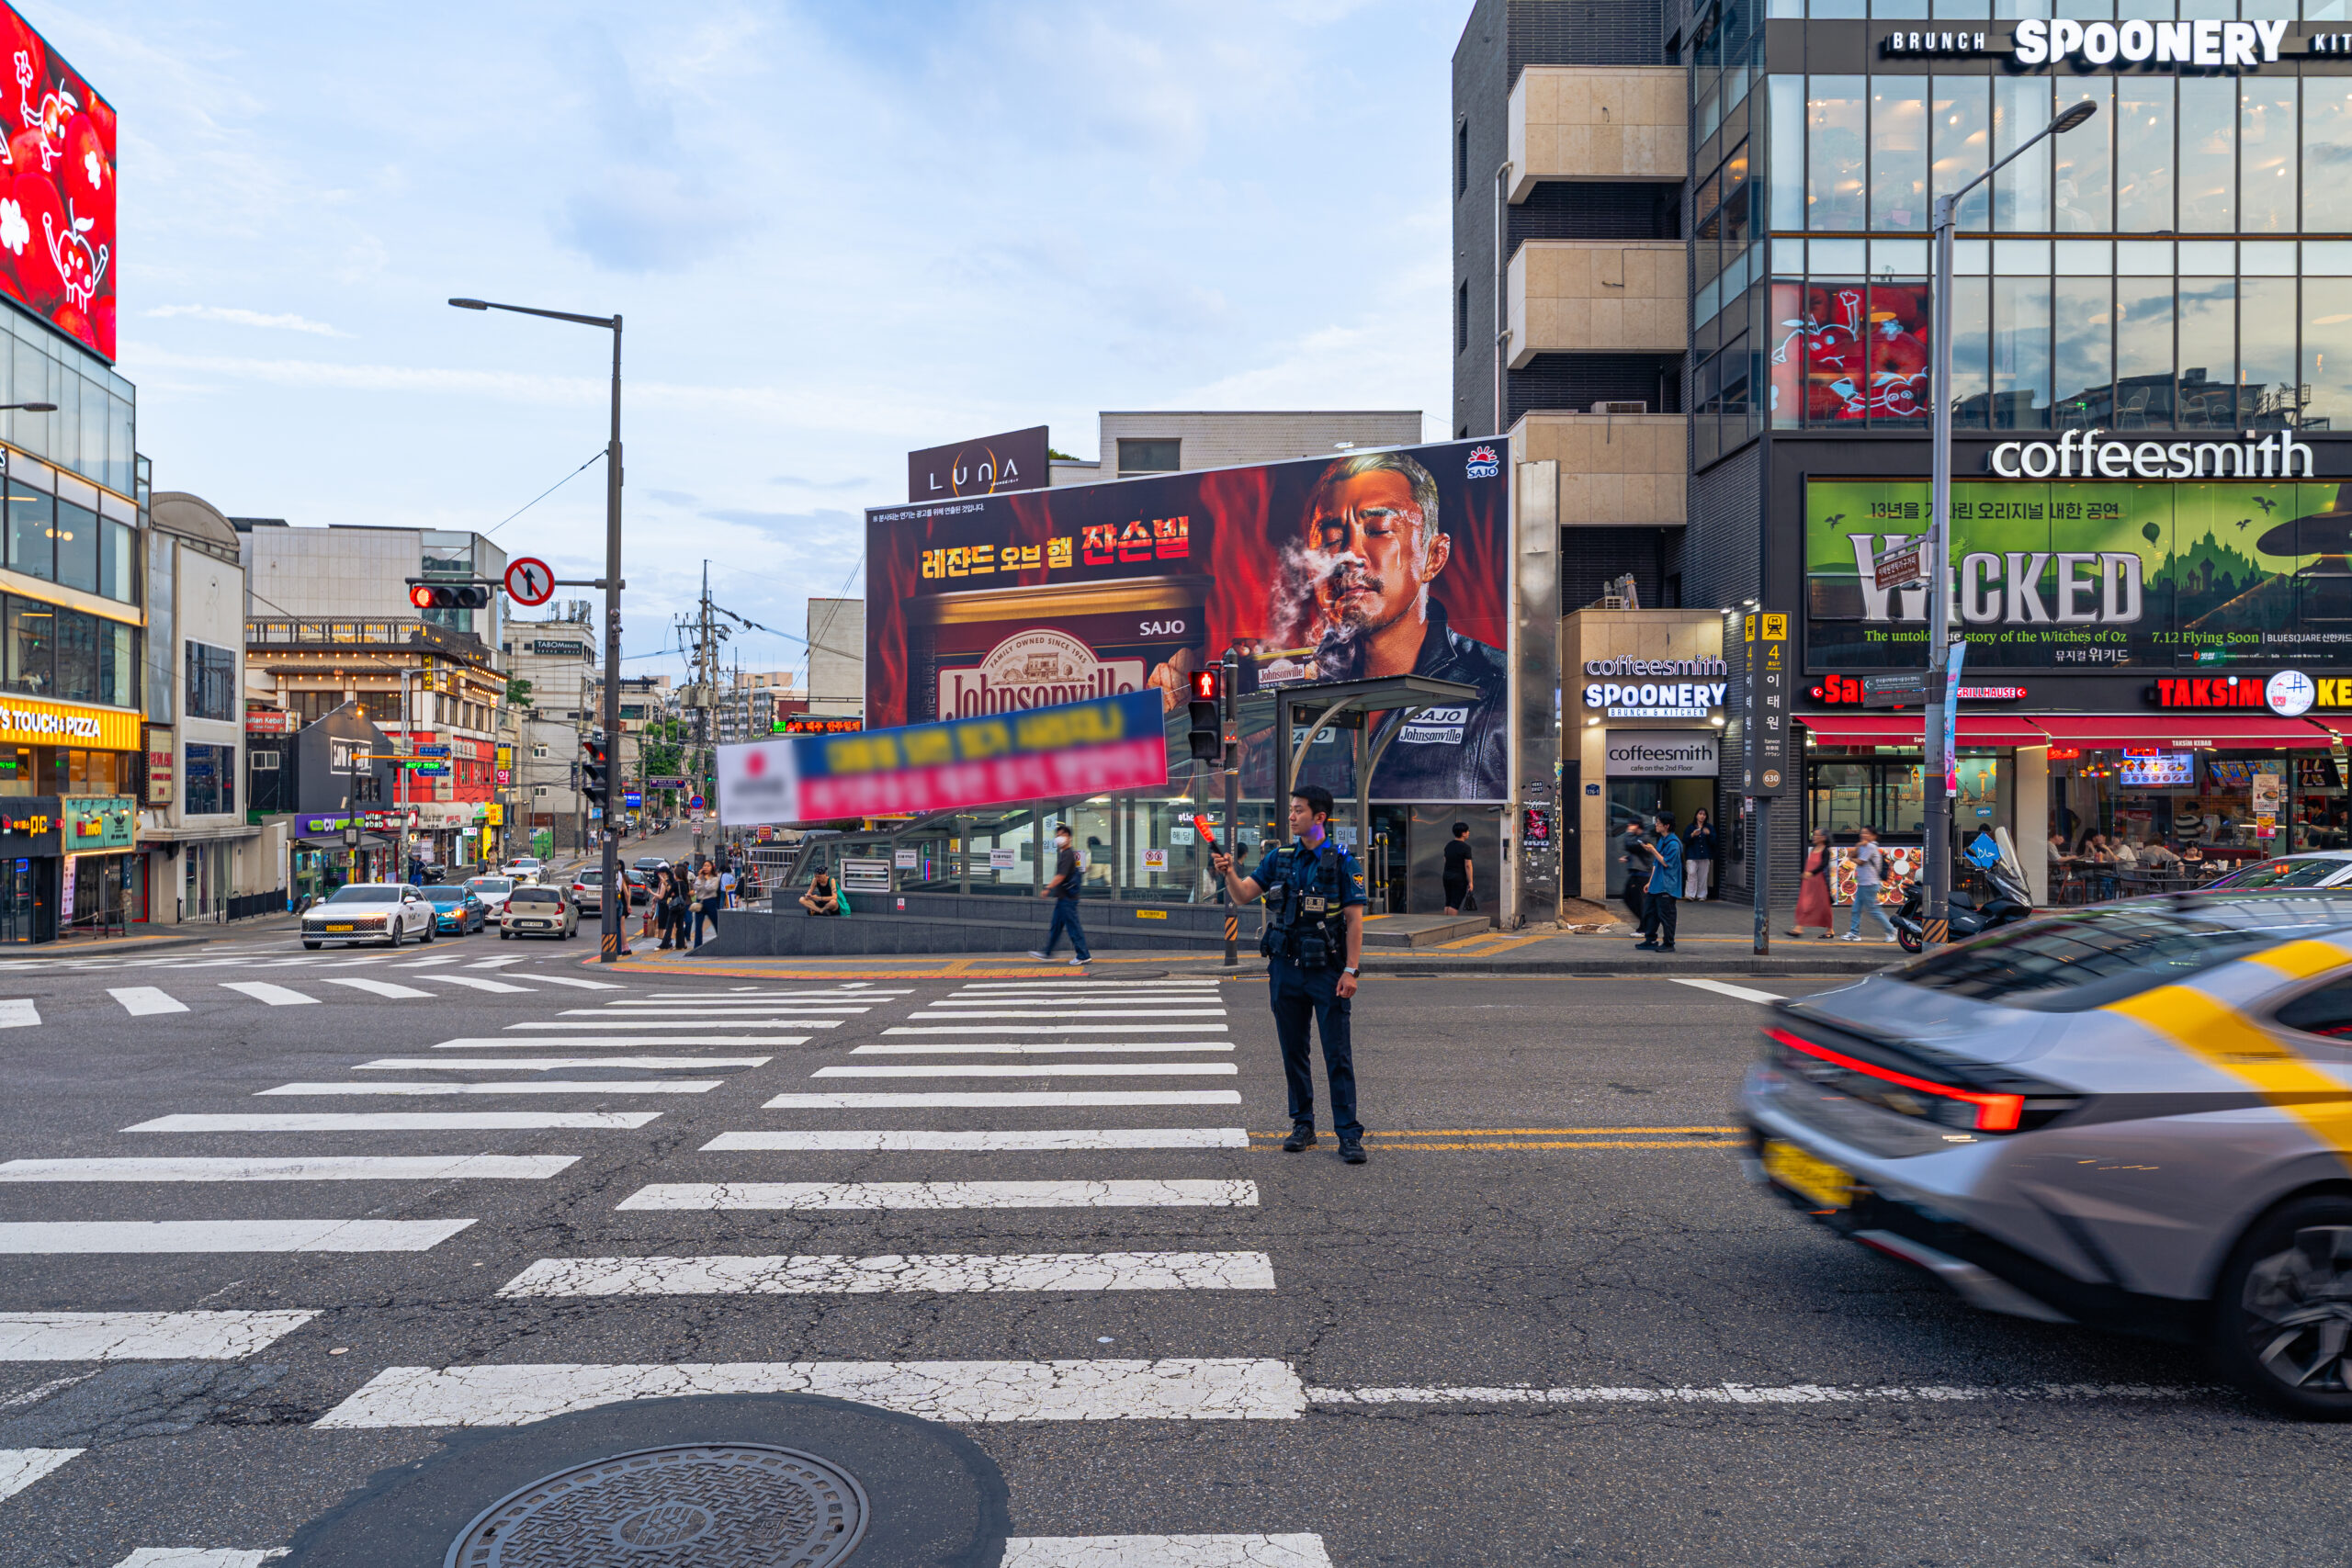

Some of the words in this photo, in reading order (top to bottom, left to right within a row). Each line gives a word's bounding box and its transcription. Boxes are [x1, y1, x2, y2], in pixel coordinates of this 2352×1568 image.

[1893, 32, 1985, 51] BRUNCH
[2016, 18, 2289, 65] SPOONERY
[2314, 33, 2352, 51] KIT
[1991, 429, 2314, 479] coffeesmith
[930, 458, 1019, 491] LUNA
[1467, 467, 1499, 479] SAJO
[899, 511, 915, 520] 연기는
[916, 508, 932, 518] 광고를
[933, 507, 944, 516] 위해
[944, 505, 961, 515] 연출된
[1871, 502, 1919, 520] 13년을
[1978, 502, 2044, 520] 오리지널
[2050, 502, 2083, 520] 내한
[2086, 502, 2120, 520] 공연
[1001, 544, 1042, 571] 오브
[1046, 536, 1073, 570] 햄
[1139, 620, 1185, 637] SAJO
[537, 640, 564, 649] TABOM
[1864, 630, 1888, 644] The
[1892, 630, 1930, 644] untold
[1964, 632, 1996, 648] story
[1999, 630, 2014, 644] of
[2016, 631, 2037, 644] the
[2040, 629, 2091, 644] Witches
[2095, 629, 2109, 644] of
[2110, 631, 2127, 644] Oz
[2152, 632, 2178, 643] 7.12
[2183, 631, 2223, 646] Flying
[2227, 631, 2259, 643] Soon
[2267, 633, 2321, 643] BLUESQUARE
[2322, 633, 2352, 644] 신한카드
[990, 644, 1013, 669] FAMILY
[1016, 637, 1045, 649] OWNED
[1047, 637, 1070, 650] SINCE
[1071, 645, 1089, 665] 1945
[1747, 646, 1753, 660] 4
[1769, 645, 1780, 660] 4
[2055, 649, 2086, 662] 뮤지컬
[2088, 647, 2130, 662] 위키드
[1587, 654, 1727, 676] coffeesmith
[1260, 667, 1304, 682] Johnsonville
[1586, 683, 1727, 707] SPOONERY
[1766, 673, 1781, 730] 이태원
[1611, 708, 1647, 716] BRUNCH
[1653, 708, 1658, 716] &
[1664, 708, 1704, 716] KITCHEN
[13, 710, 58, 734] TOUCH
[59, 720, 65, 732] &
[66, 716, 101, 738] PIZZA
[265, 716, 285, 725] Kebab
[1400, 727, 1461, 741] Johnsonville
[1609, 745, 1713, 761] coffeesmith
[2126, 747, 2156, 756] OPEN
[323, 818, 335, 831] CU
[1976, 847, 1995, 859] حلال
